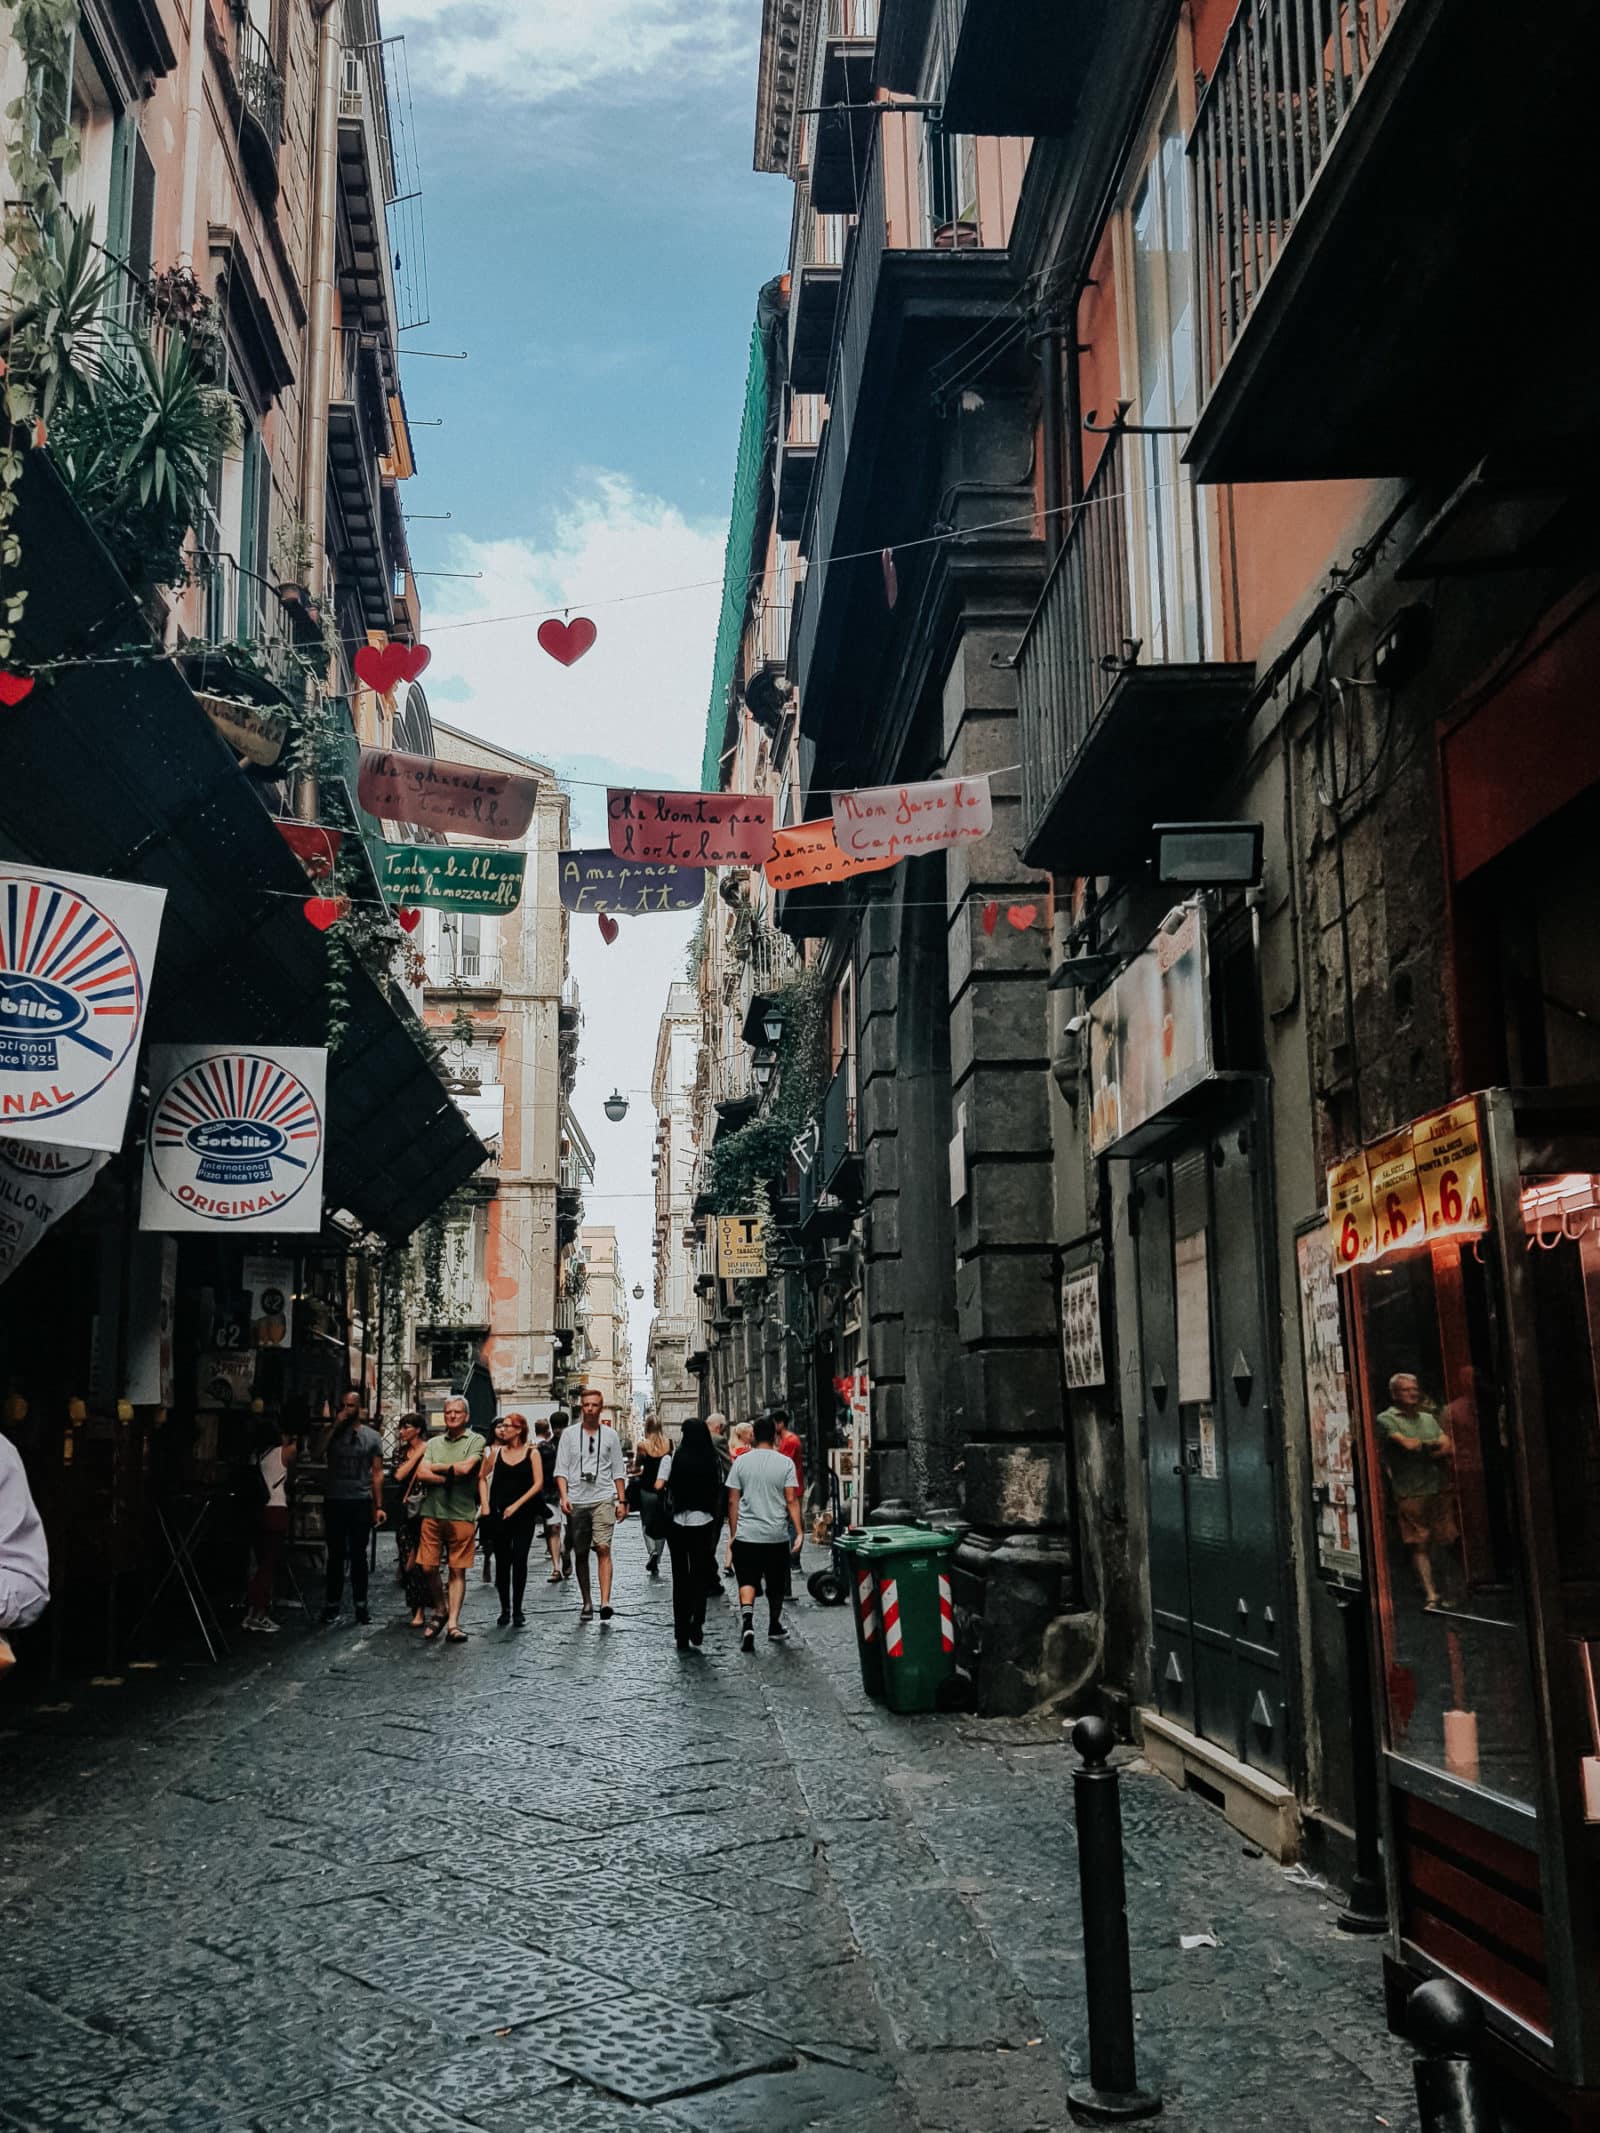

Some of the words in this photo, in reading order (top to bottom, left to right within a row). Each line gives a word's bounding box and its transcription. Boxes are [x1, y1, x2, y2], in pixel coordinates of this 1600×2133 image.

[609, 795, 646, 820] Che
[728, 814, 766, 838] per
[838, 794, 886, 820] Non
[896, 789, 947, 825] fare
[954, 783, 980, 808] la
[385, 853, 428, 875] Tonda
[197, 1135, 272, 1148] Sorbillo
[202, 1160, 268, 1172] International
[178, 1185, 286, 1215] ORIGINAL
[722, 1219, 733, 1256] LOTTO
[738, 1219, 758, 1244] T
